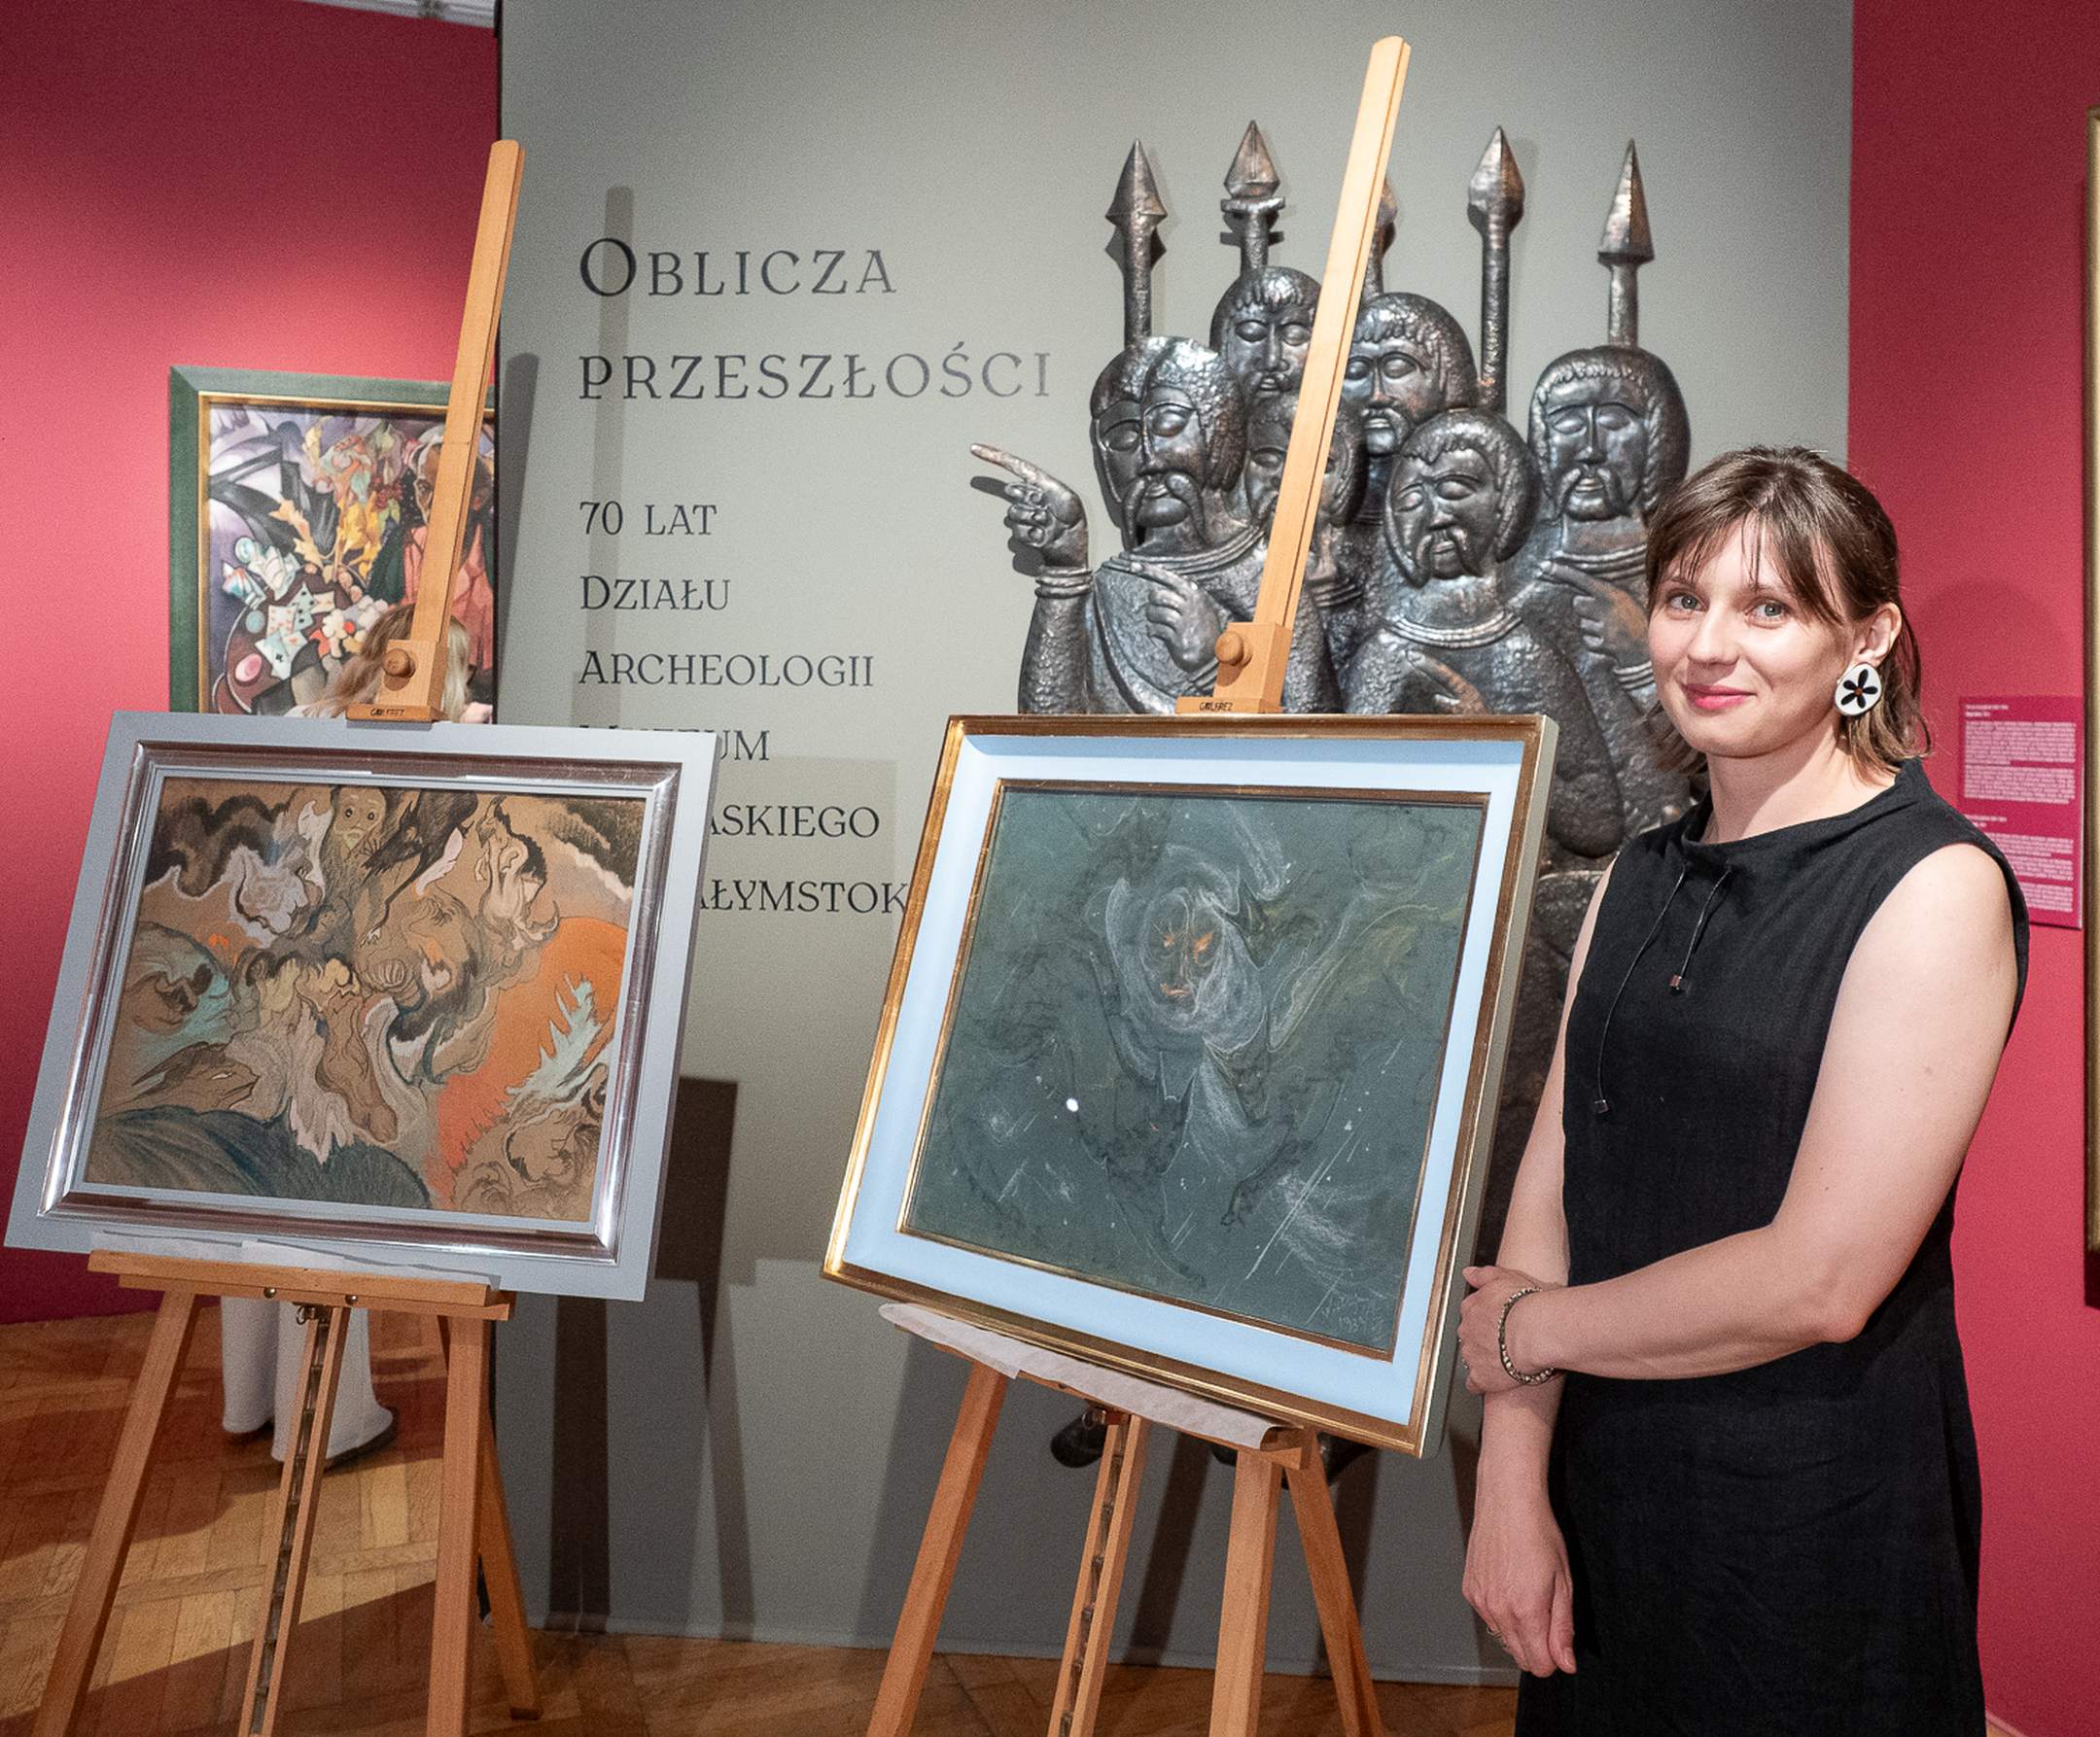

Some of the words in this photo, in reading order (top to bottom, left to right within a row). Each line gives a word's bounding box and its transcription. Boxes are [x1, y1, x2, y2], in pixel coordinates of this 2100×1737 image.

[579, 237, 896, 296] OBLICZA
[579, 341, 1050, 400] PRZESZŁOŚCI
[580, 502, 624, 536] 70
[645, 504, 718, 536] LAT
[580, 575, 731, 610] DZIAŁU
[578, 649, 874, 686] ARCHEOLOGII
[700, 880, 907, 915] ŁYMSTOK
